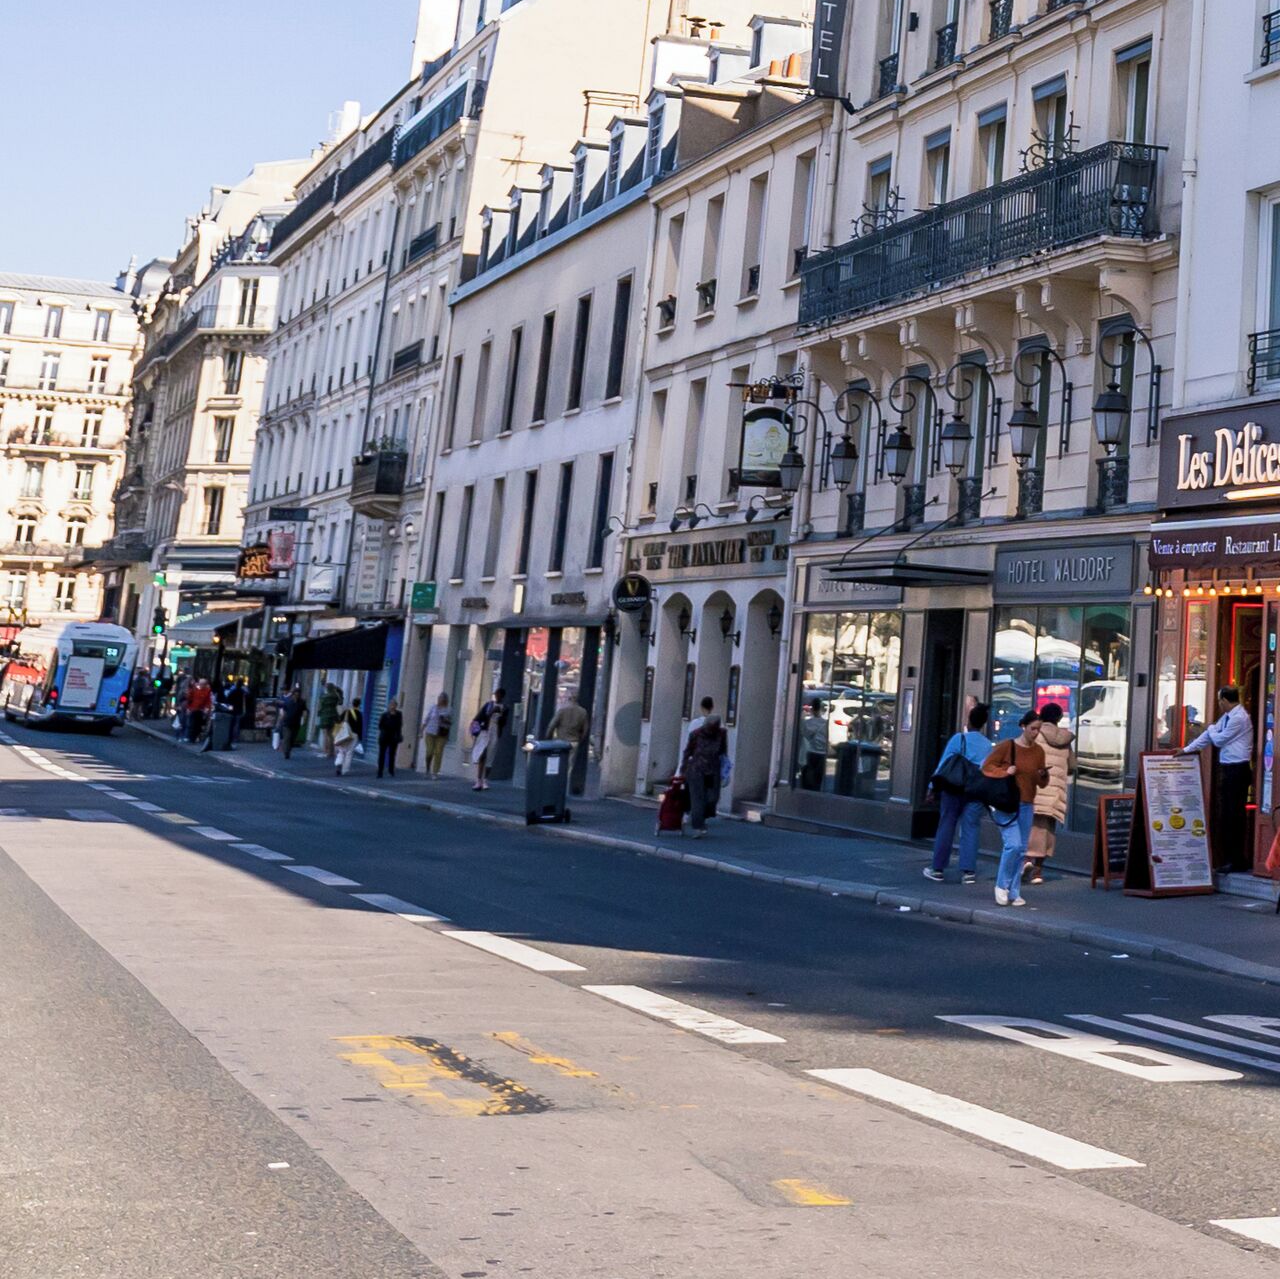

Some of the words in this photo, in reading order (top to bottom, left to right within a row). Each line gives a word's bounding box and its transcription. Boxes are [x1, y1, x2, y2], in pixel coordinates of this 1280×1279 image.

[1177, 433, 1214, 490] Les
[1153, 539, 1173, 555] Vente
[1175, 540, 1180, 554] à
[1181, 541, 1217, 557] emporter
[1225, 536, 1270, 555] Restaurant
[1008, 560, 1046, 584] HOTEL
[1055, 556, 1115, 582] WALDORF
